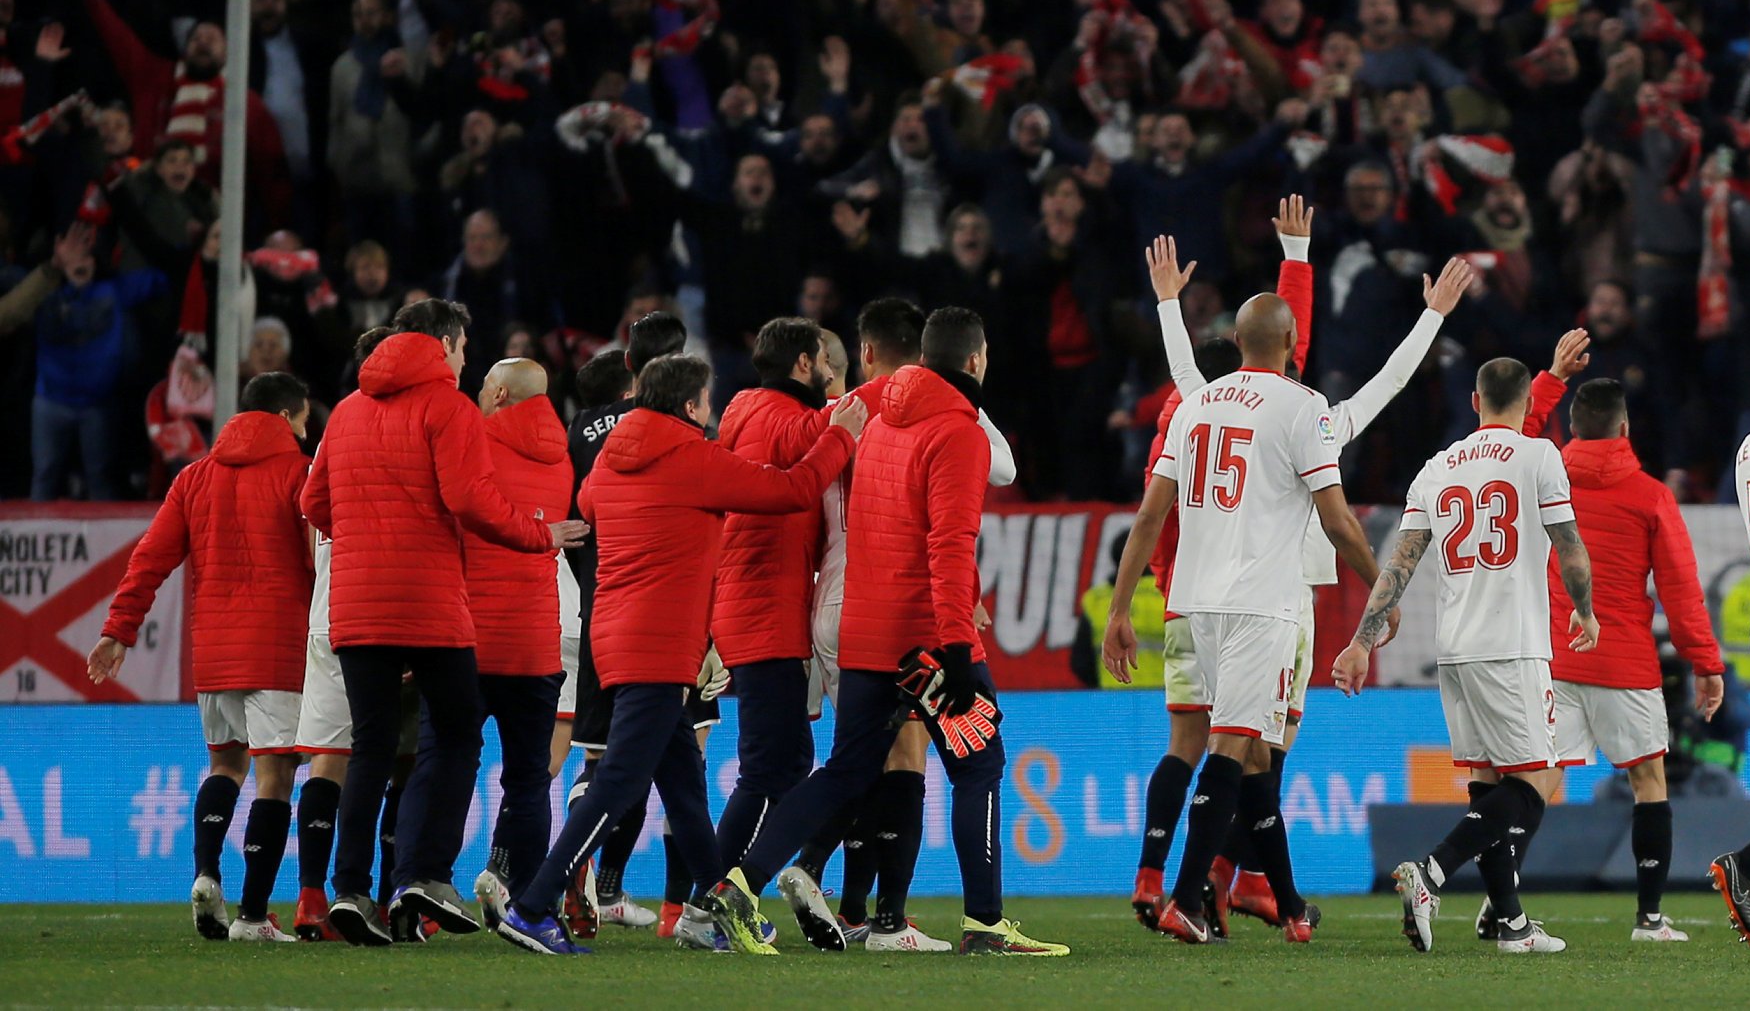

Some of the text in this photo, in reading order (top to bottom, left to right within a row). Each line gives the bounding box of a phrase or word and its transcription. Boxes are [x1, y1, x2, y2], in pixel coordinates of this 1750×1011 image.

[1201, 387, 1264, 411] NZONZI
[1187, 423, 1254, 513] 15
[1447, 443, 1515, 470] SANDRO
[1437, 480, 1519, 575] 23
